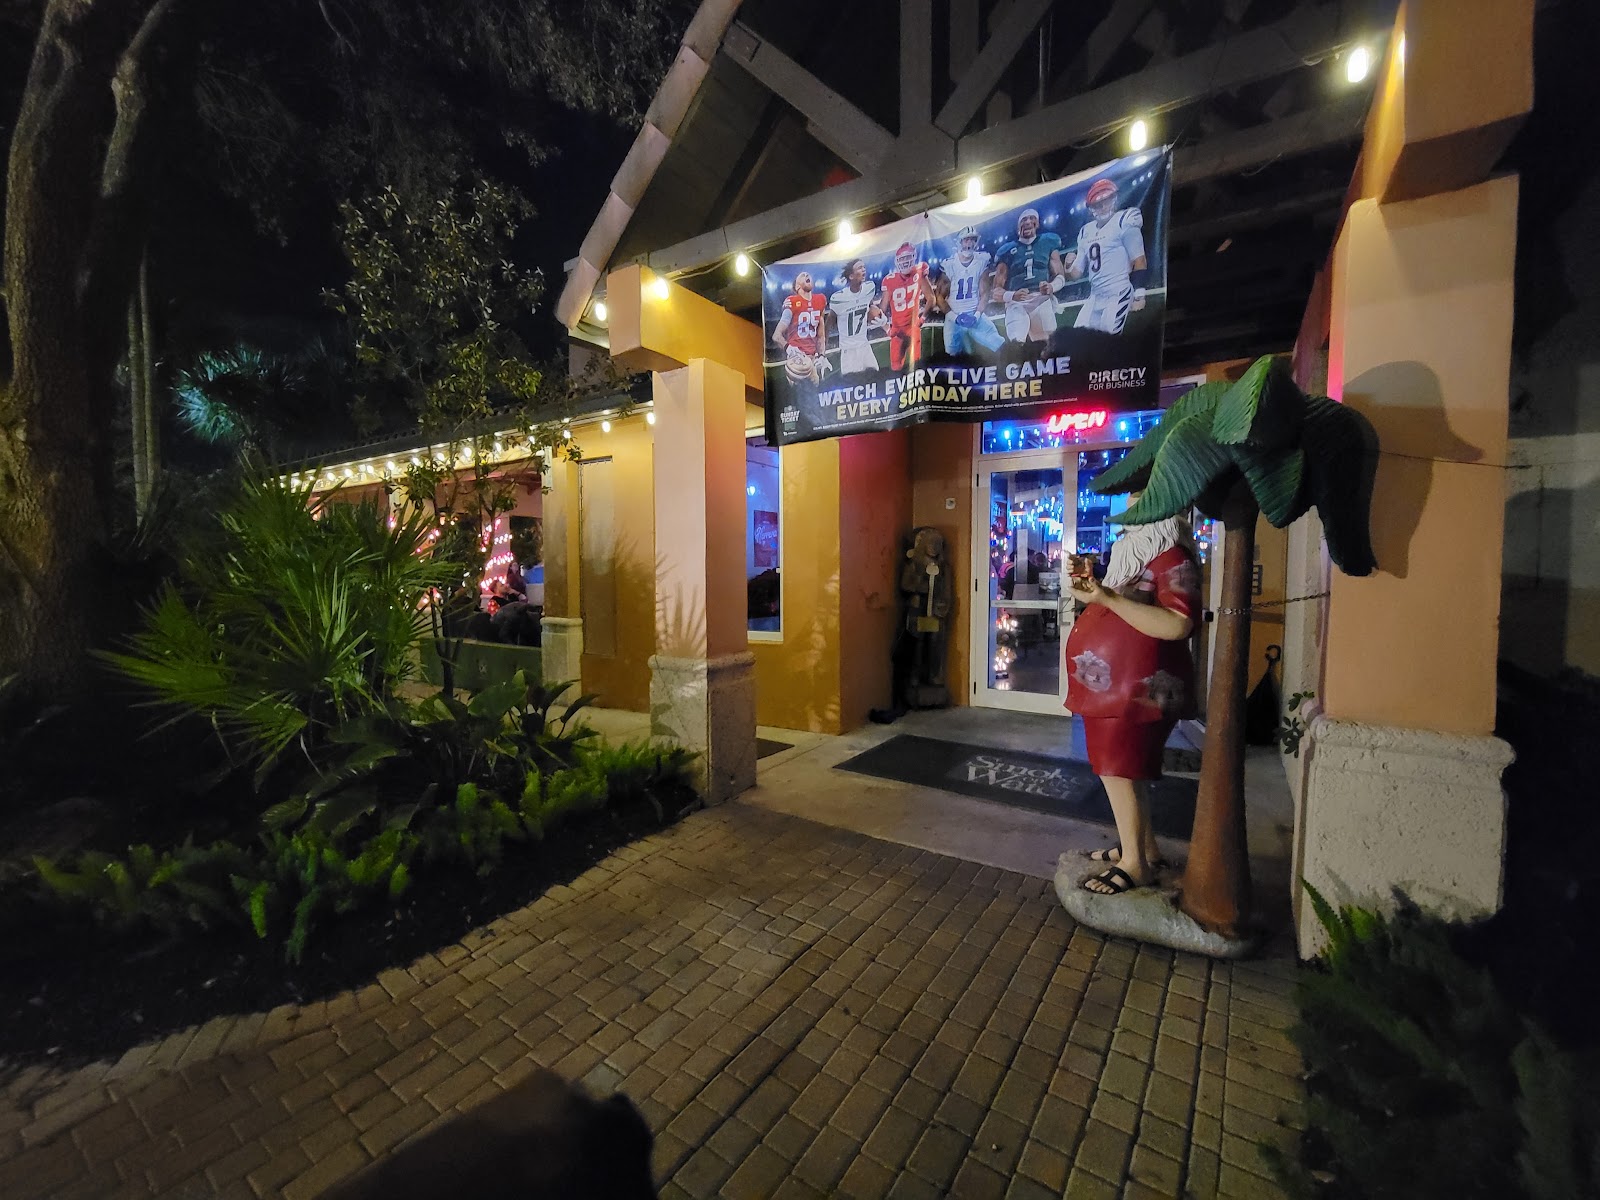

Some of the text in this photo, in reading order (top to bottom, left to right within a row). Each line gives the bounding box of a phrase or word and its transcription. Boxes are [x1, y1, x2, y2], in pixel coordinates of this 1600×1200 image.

[1024, 258, 1036, 280] 1
[1088, 242, 1101, 273] 9
[892, 282, 919, 312] 87
[955, 276, 974, 300] 11
[797, 310, 821, 338] 85
[847, 307, 868, 337] 17
[818, 356, 1071, 407] WATCH EVERY LIVE GAME
[1088, 379, 1146, 391] FOR BUSINESS
[1089, 366, 1147, 384] DIRECTV
[836, 397, 892, 420] EVERY
[898, 384, 970, 409] SUNDAY
[984, 379, 1043, 402] HERE
[1047, 410, 1107, 434] OPEN
